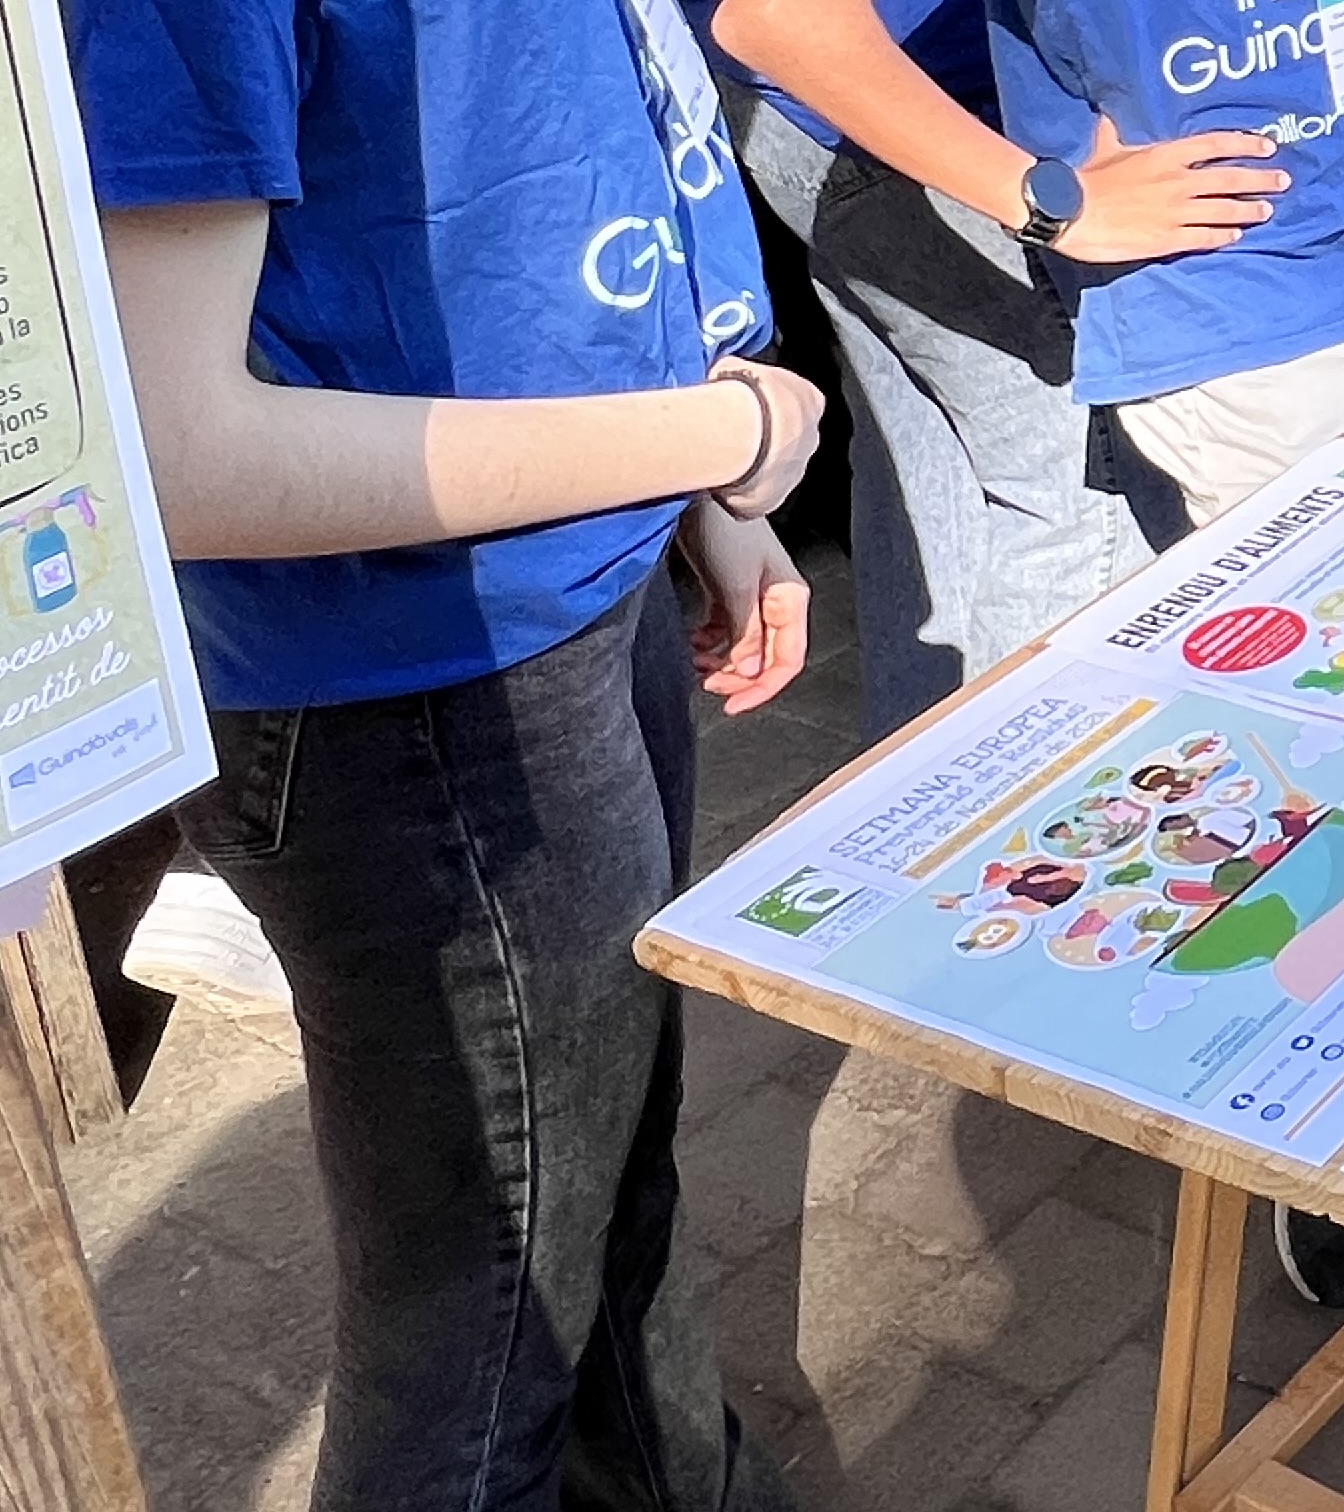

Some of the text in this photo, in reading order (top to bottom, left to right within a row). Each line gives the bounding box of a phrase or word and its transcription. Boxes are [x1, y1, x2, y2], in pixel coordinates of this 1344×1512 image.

[8, 317, 31, 340] la
[0, 606, 114, 680] ocessos
[1107, 573, 1229, 648] ENRENOU
[0, 641, 132, 729] entit de
[827, 770, 960, 857] SETMANA
[951, 695, 1067, 770] EUROPEA
[854, 785, 973, 865] Prevenció
[966, 763, 1005, 784] de
[924, 818, 961, 837] de
[1039, 737, 1072, 755] de
